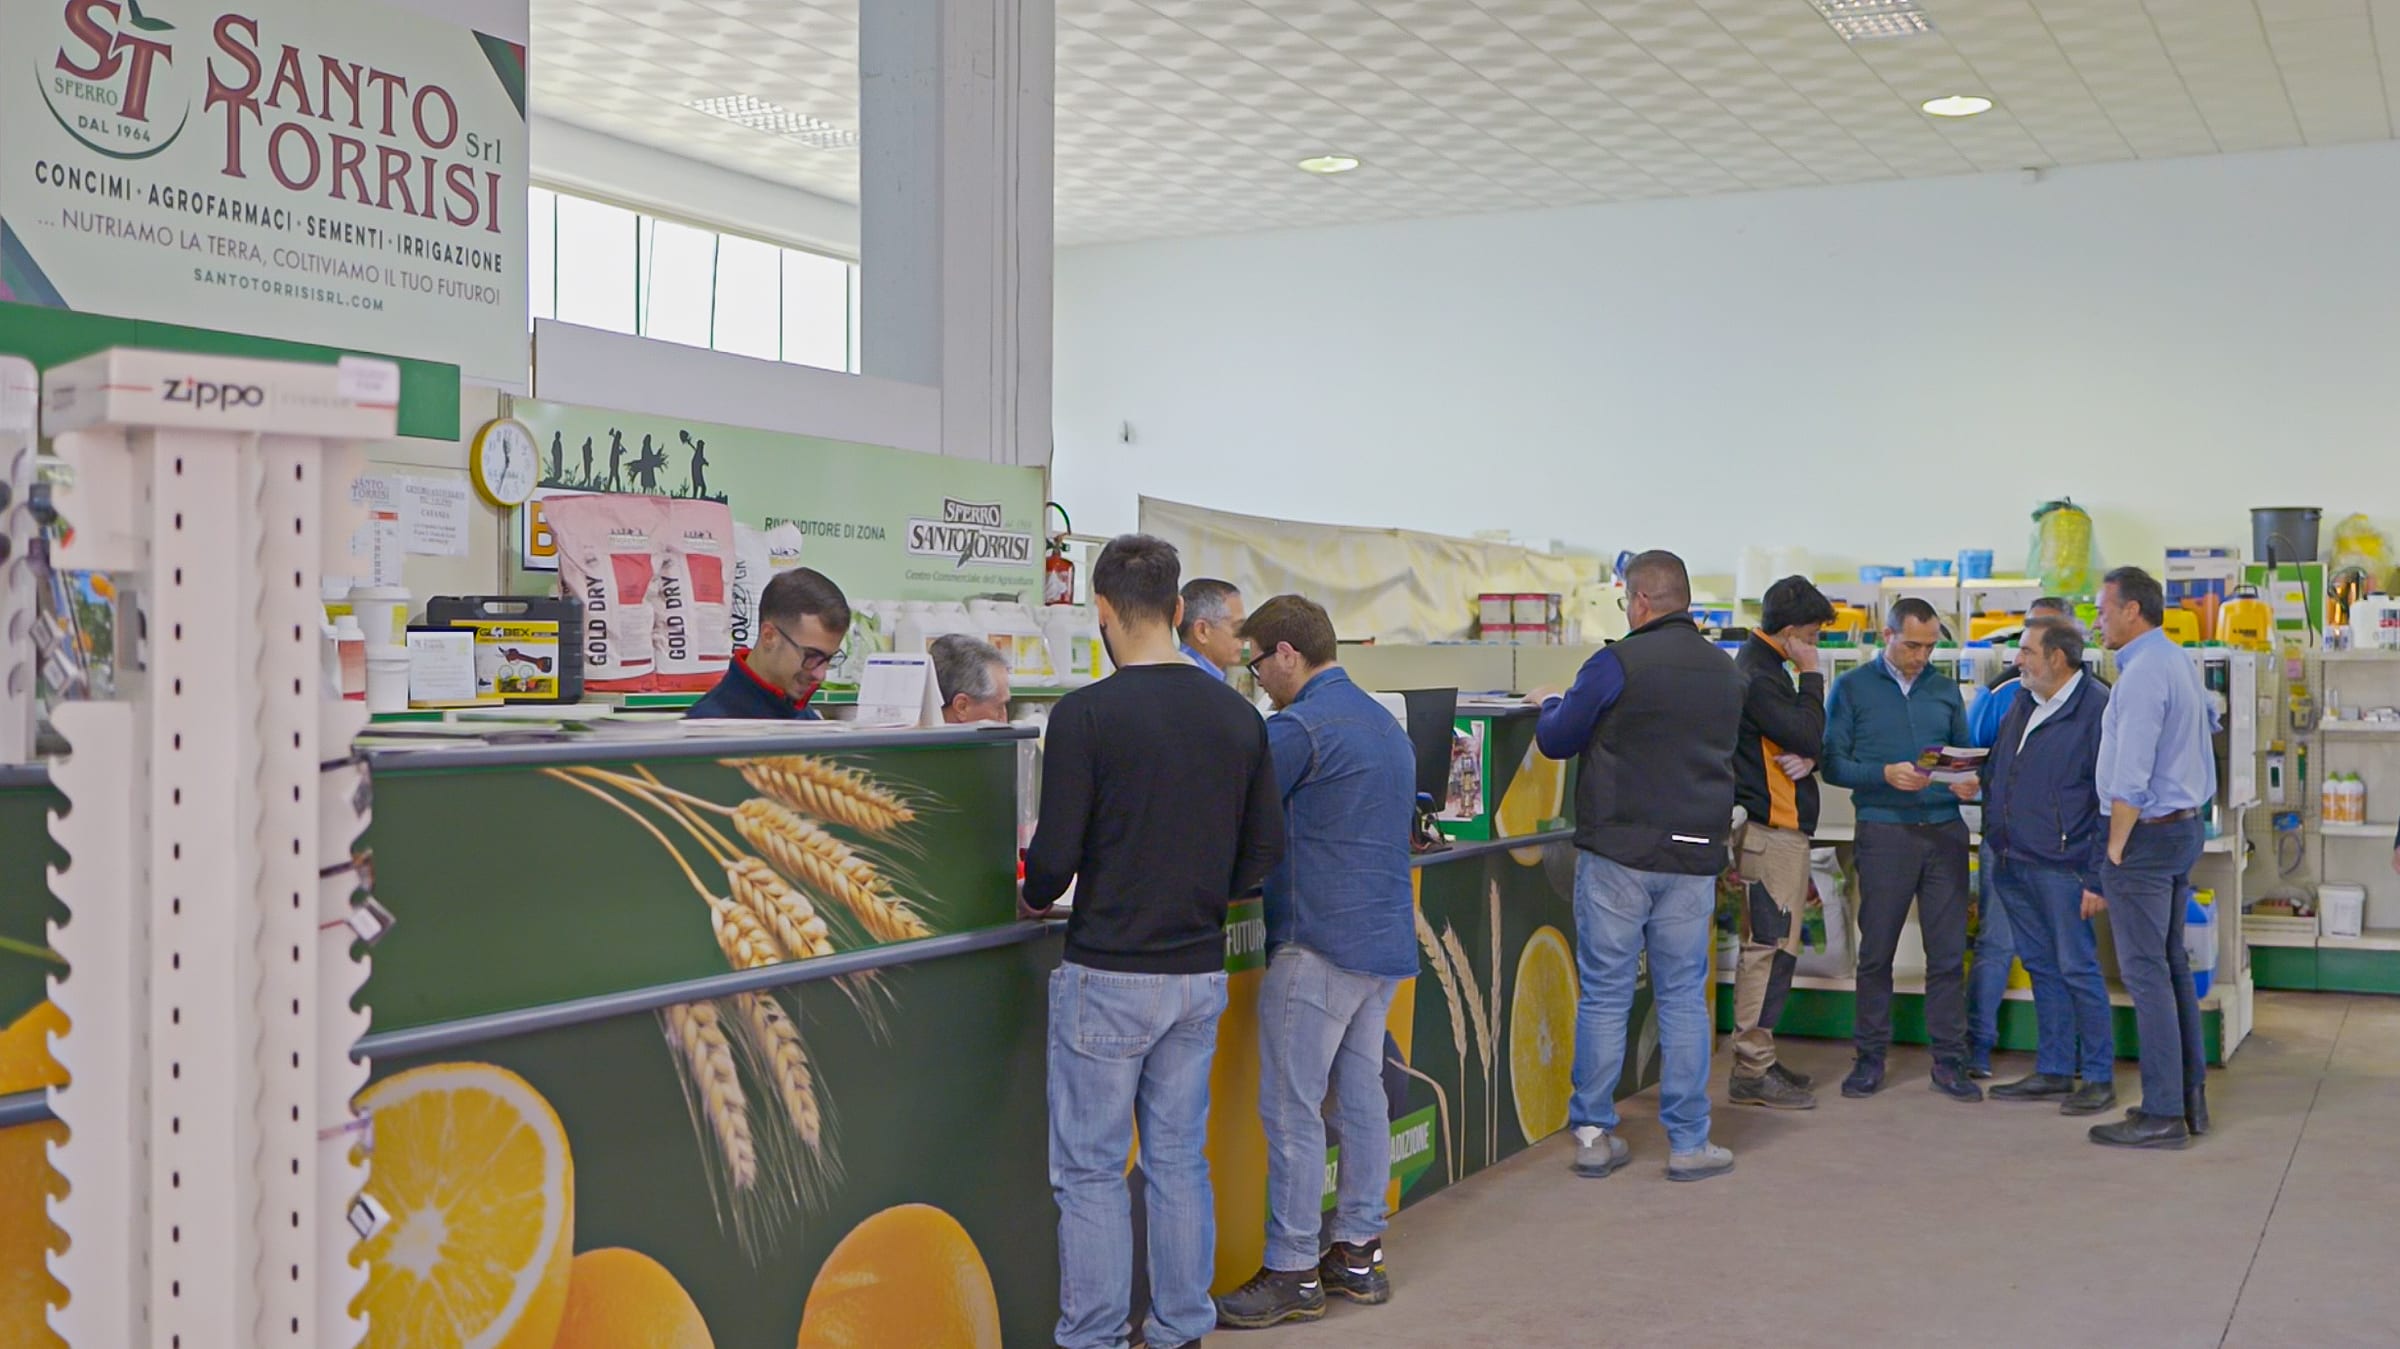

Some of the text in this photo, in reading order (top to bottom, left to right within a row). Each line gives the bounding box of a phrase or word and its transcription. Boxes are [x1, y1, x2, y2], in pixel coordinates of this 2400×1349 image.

[54, 77, 118, 106] SFERRO
[205, 13, 459, 150] SANTO
[78, 115, 151, 142] DAL 1964
[466, 133, 502, 164] Srl
[204, 97, 502, 234] TORRISI
[35, 160, 502, 273] CONCIMI AGROFARMACI SEMENTI IRRIGAZIONE
[62, 208, 173, 247] NUTRIAMO
[180, 230, 201, 252] LA
[207, 235, 268, 267] TERRA,
[273, 248, 380, 283] COLTIVIAMO
[385, 269, 396, 288] IL
[401, 271, 433, 294] TUO
[194, 268, 384, 312] SANTOTORRISISRL.COM
[163, 376, 264, 411] zippo
[843, 523, 855, 538] DI
[857, 525, 886, 540] ZONA
[945, 501, 1000, 527] SFERRO
[586, 575, 606, 611] DRY
[663, 576, 686, 660] GOLD DRY
[589, 619, 607, 666] GOLD
